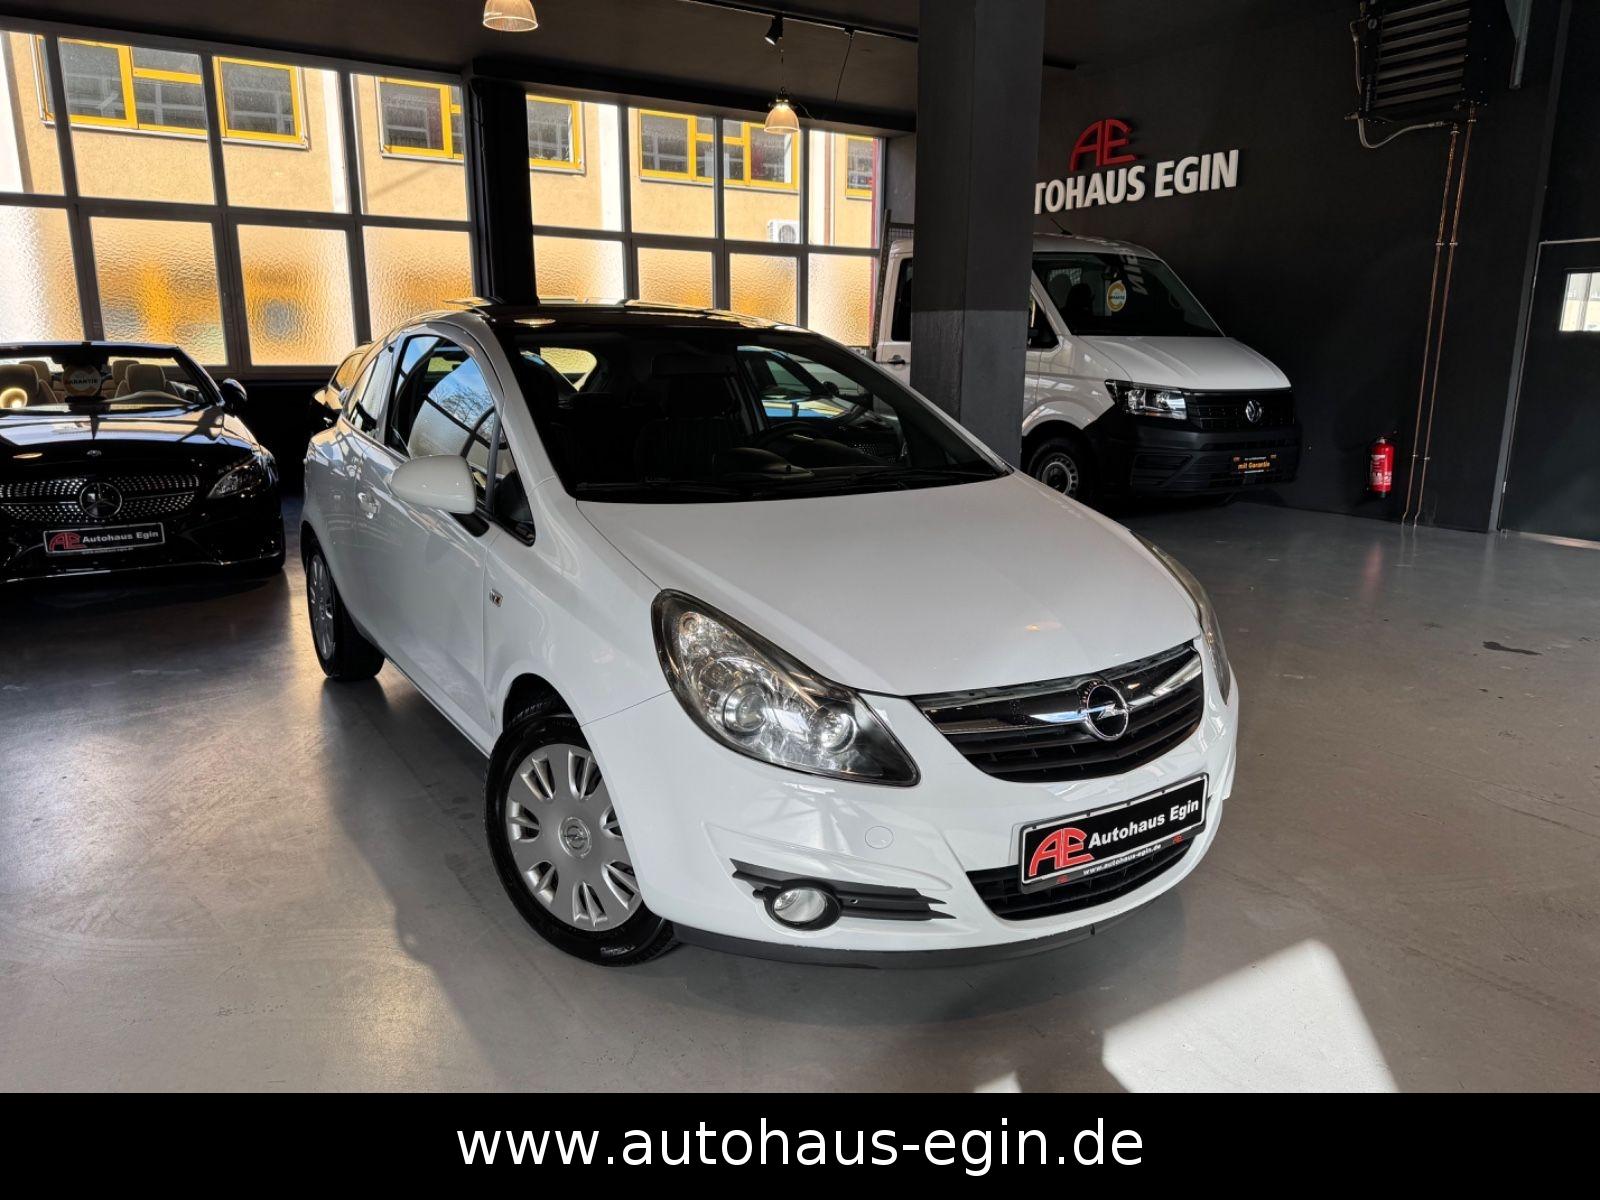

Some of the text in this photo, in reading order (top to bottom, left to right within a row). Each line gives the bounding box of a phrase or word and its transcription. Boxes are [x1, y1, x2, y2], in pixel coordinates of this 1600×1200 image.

[1069, 119, 1136, 172] AE
[1154, 149, 1239, 198] EGIN
[82, 531, 159, 543] Autohaus Egin
[1088, 799, 1199, 849] Autohaus Egin
[1029, 827, 1095, 877] AE
